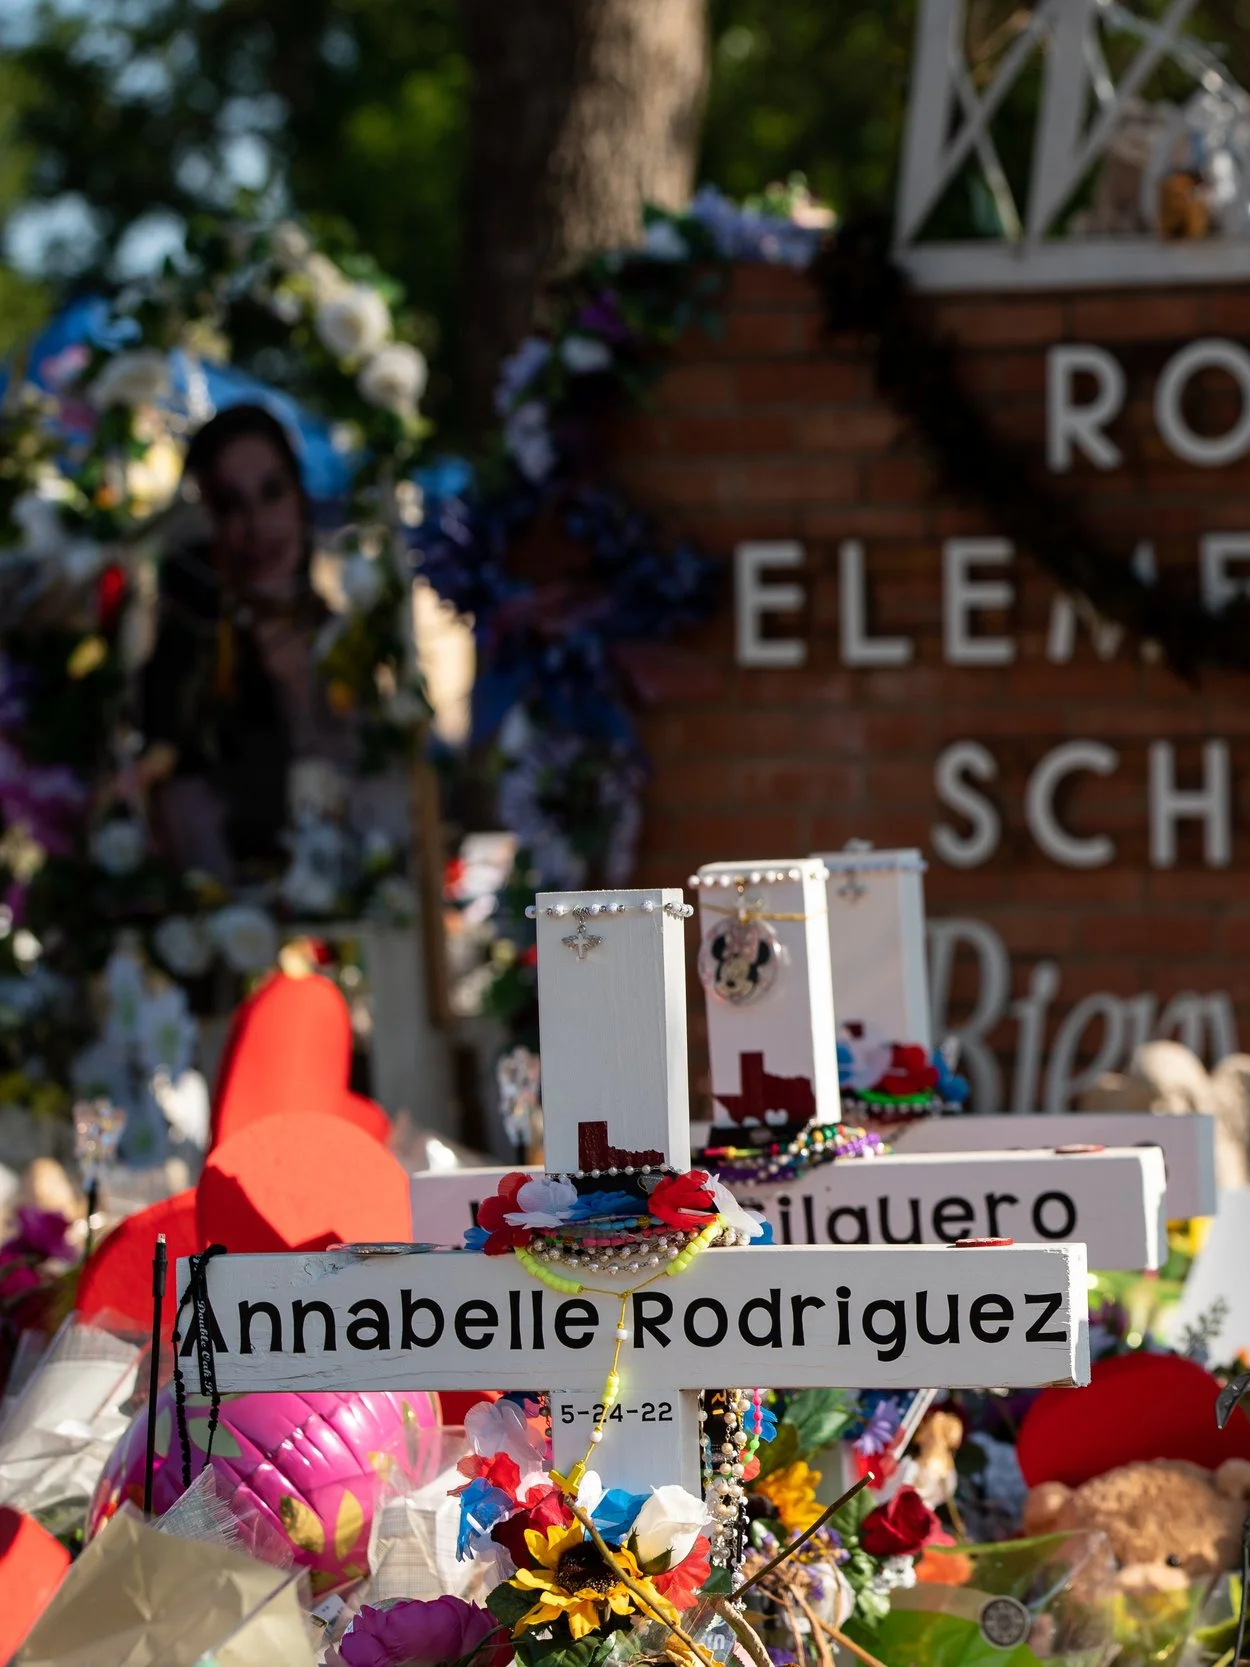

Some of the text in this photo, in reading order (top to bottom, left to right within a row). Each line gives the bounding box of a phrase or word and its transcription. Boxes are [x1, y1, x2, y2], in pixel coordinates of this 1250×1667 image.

[178, 1285, 1068, 1362] Annabelle Rodriguez
[560, 1402, 673, 1424] 5-24-22
